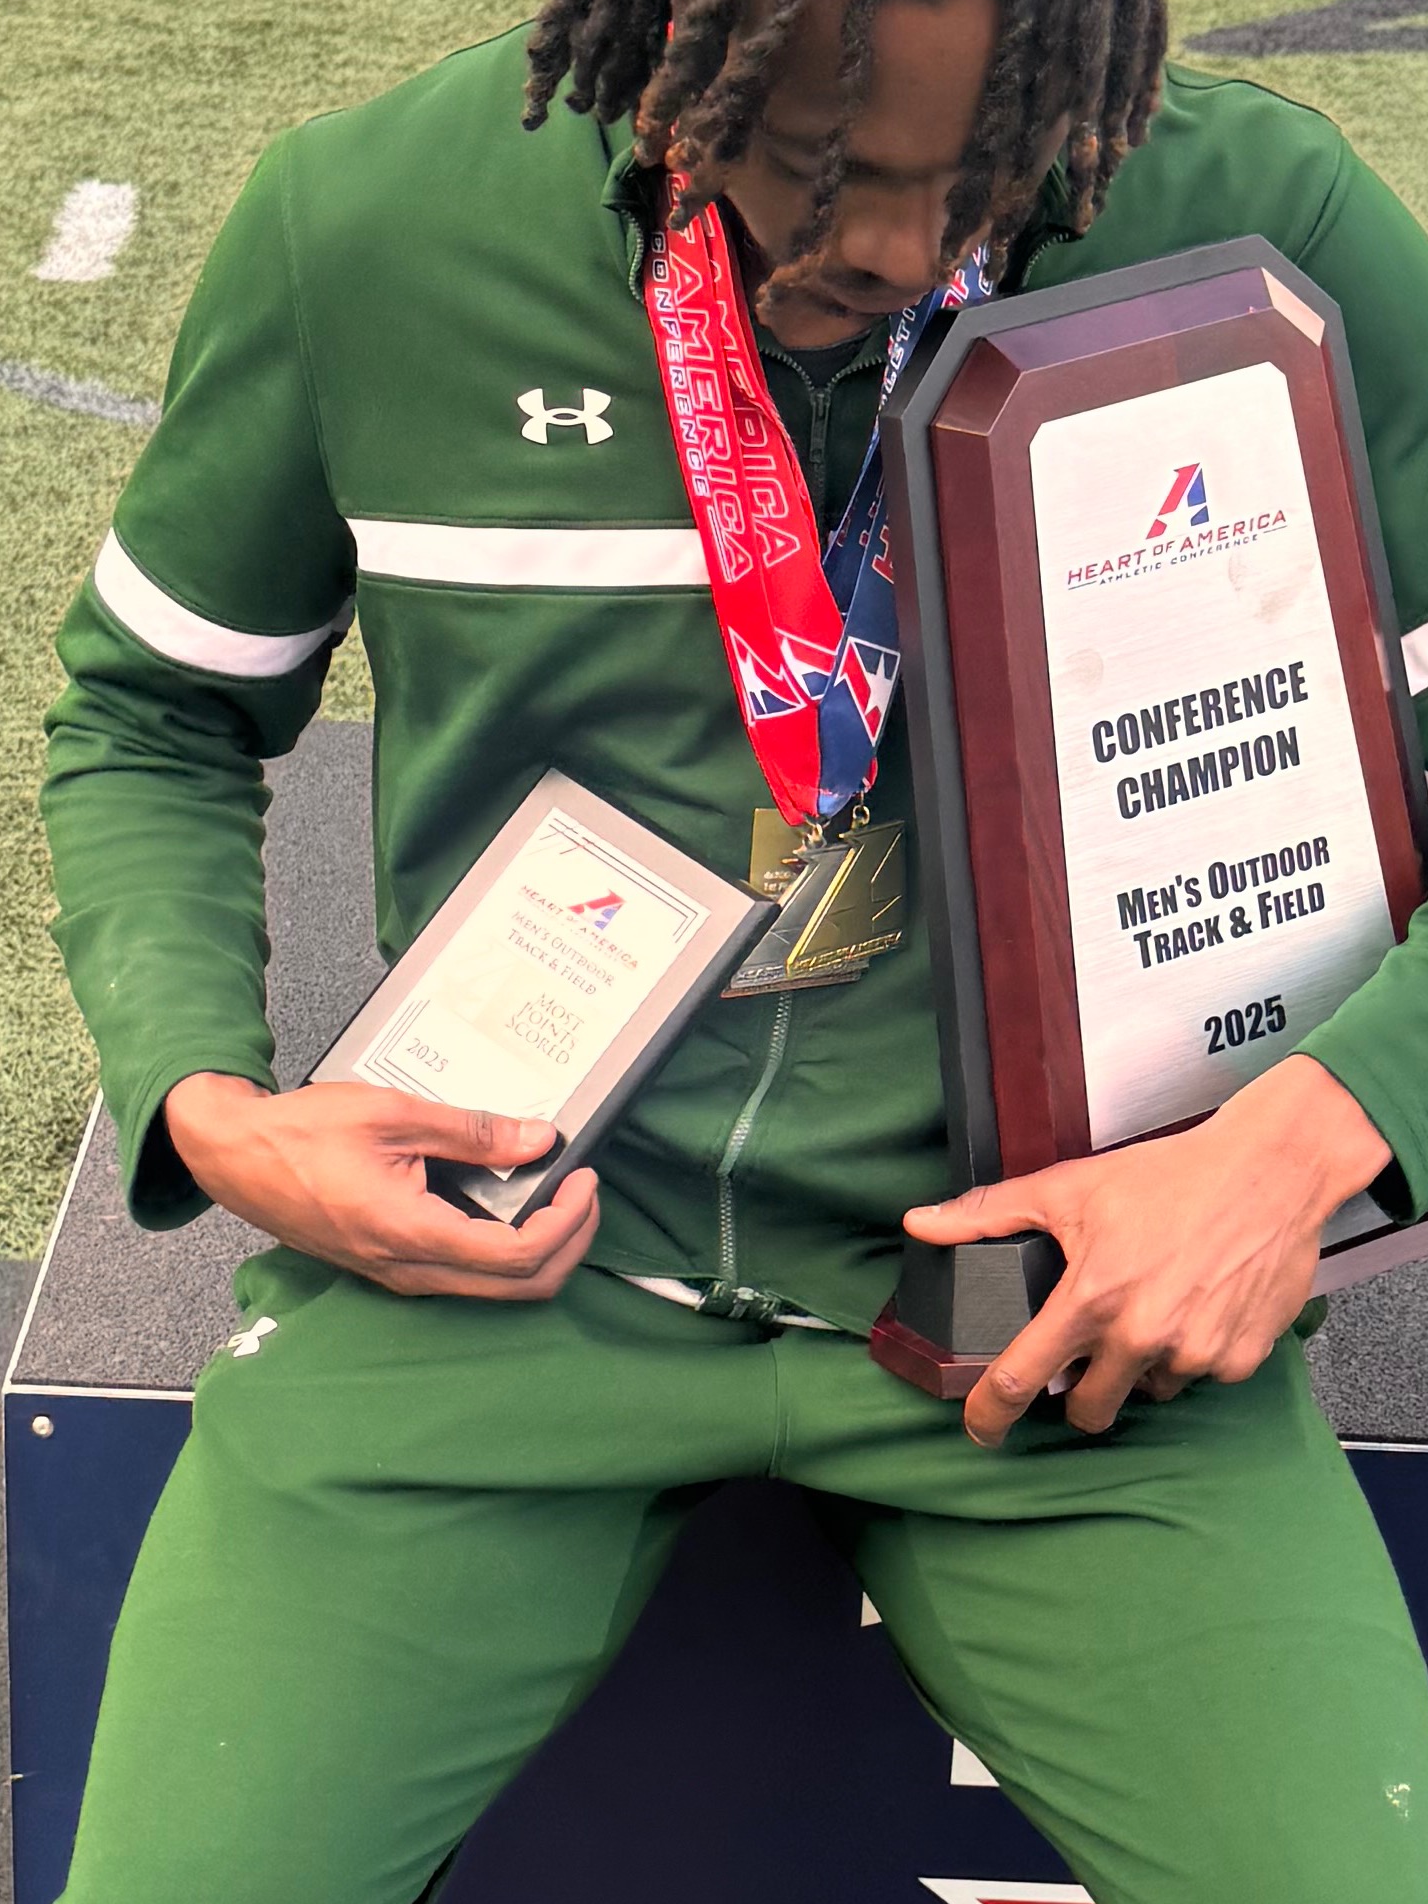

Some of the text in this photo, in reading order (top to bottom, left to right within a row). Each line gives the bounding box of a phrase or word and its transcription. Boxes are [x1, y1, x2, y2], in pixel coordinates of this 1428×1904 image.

[651, 230, 712, 498] CONFERENCE
[668, 249, 754, 583] AMERICA
[1067, 509, 1287, 585] HEART OF AMERICA
[1099, 533, 1259, 585] ATHLETIC CONFERENCE
[1091, 660, 1309, 766] CONFERENCE
[1115, 725, 1302, 822] CHAMPION
[1207, 835, 1331, 894] OUTDOOR
[520, 884, 564, 915] HEART
[579, 926, 639, 969] AMERICA
[1132, 880, 1327, 971] TRACK & FIELD
[504, 1014, 571, 1065] SCORED
[516, 1001, 577, 1050] POINTS
[534, 991, 585, 1032] MOST
[1202, 993, 1287, 1056] 2025
